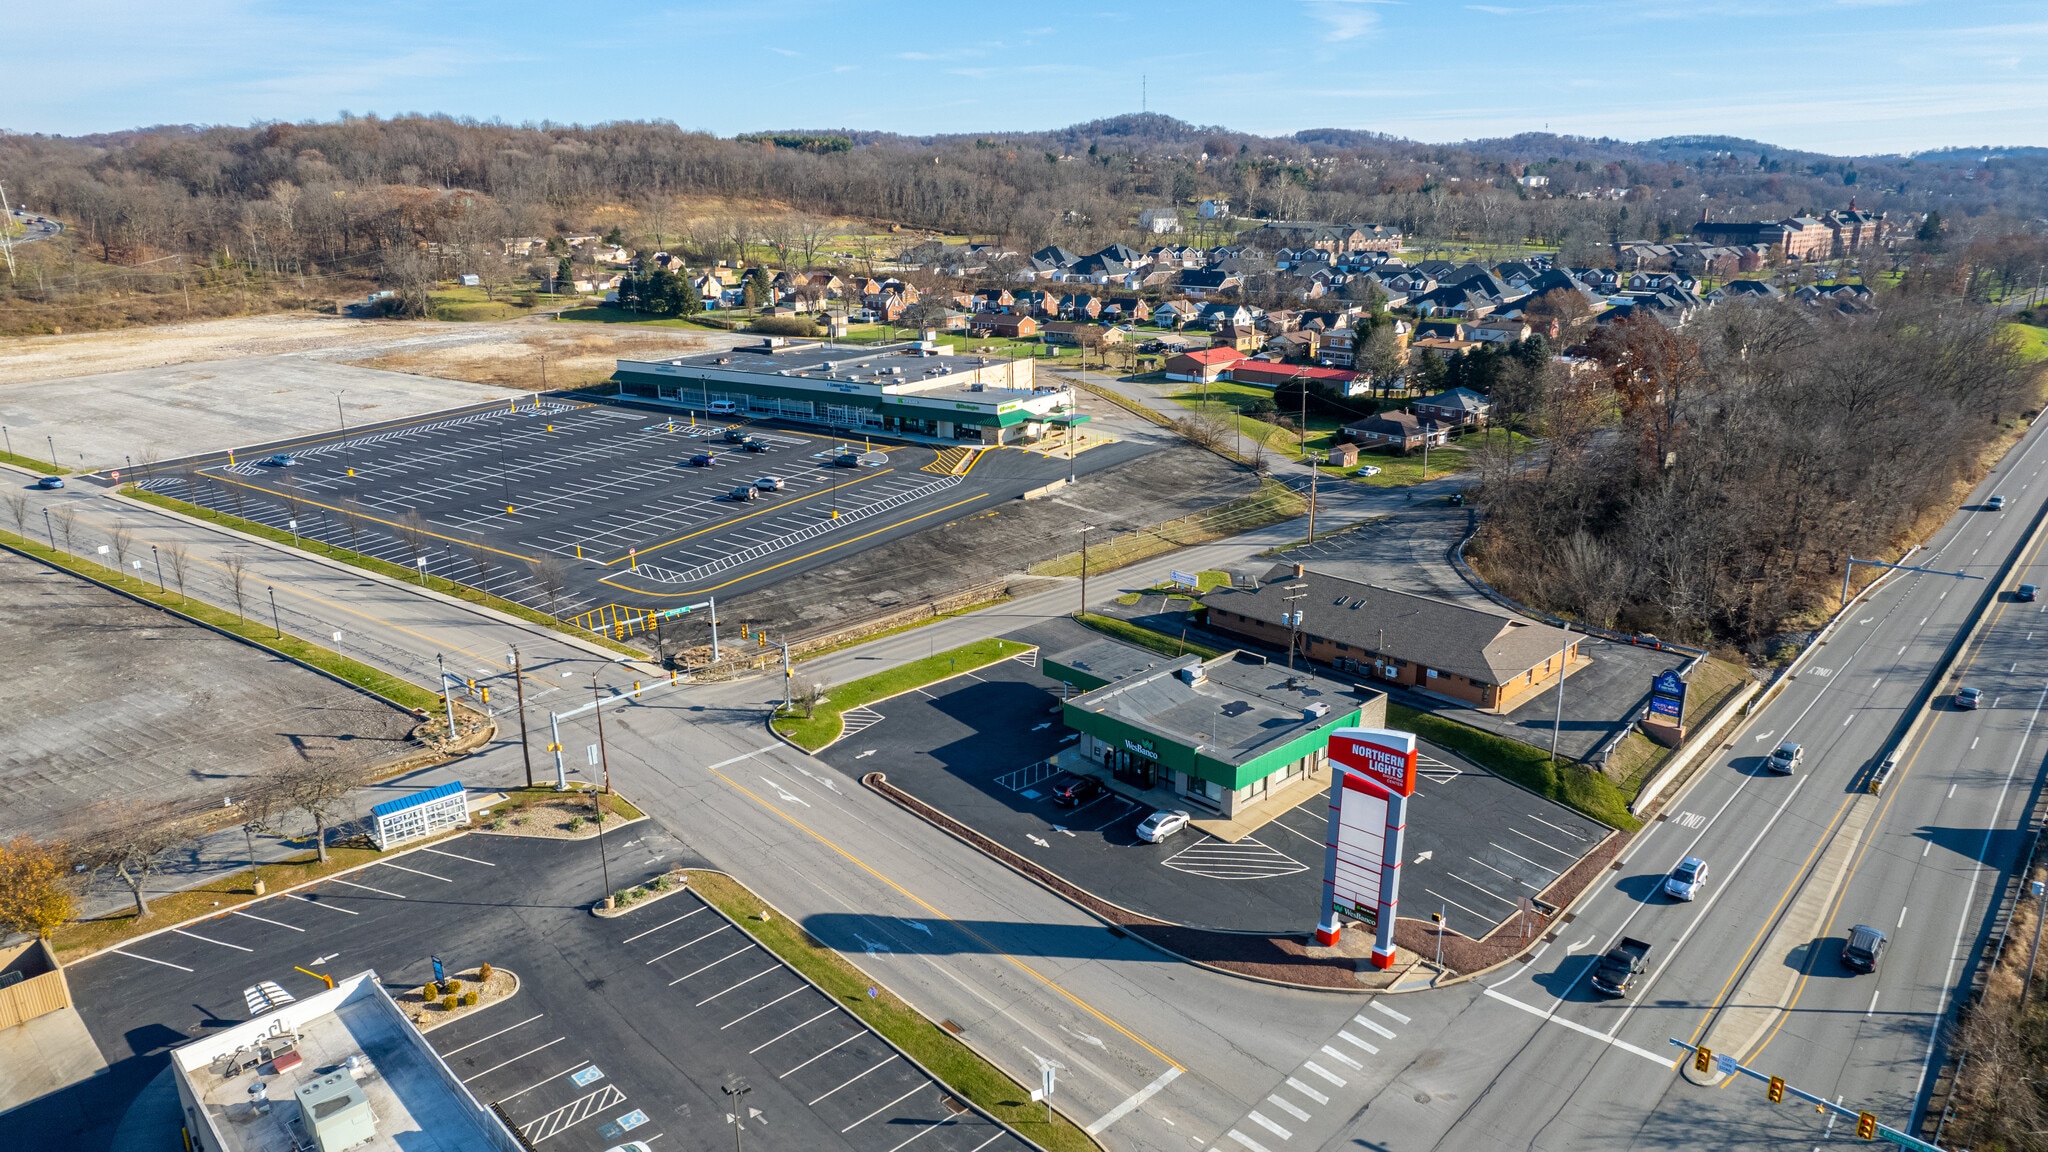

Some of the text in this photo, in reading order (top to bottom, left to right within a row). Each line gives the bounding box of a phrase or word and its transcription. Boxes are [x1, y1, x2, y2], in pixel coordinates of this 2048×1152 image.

[1806, 665, 1833, 677] ONLY
[1124, 739, 1158, 760] WesBanco
[1351, 743, 1405, 768] NORTHERN
[1368, 759, 1404, 779] LIGHTS
[1382, 773, 1404, 784] SHOPPING
[1386, 778, 1403, 787] CENTER
[1671, 810, 1706, 829] ONLY
[1344, 907, 1376, 926] WesBanco
[1883, 1129, 1920, 1151] Economy
